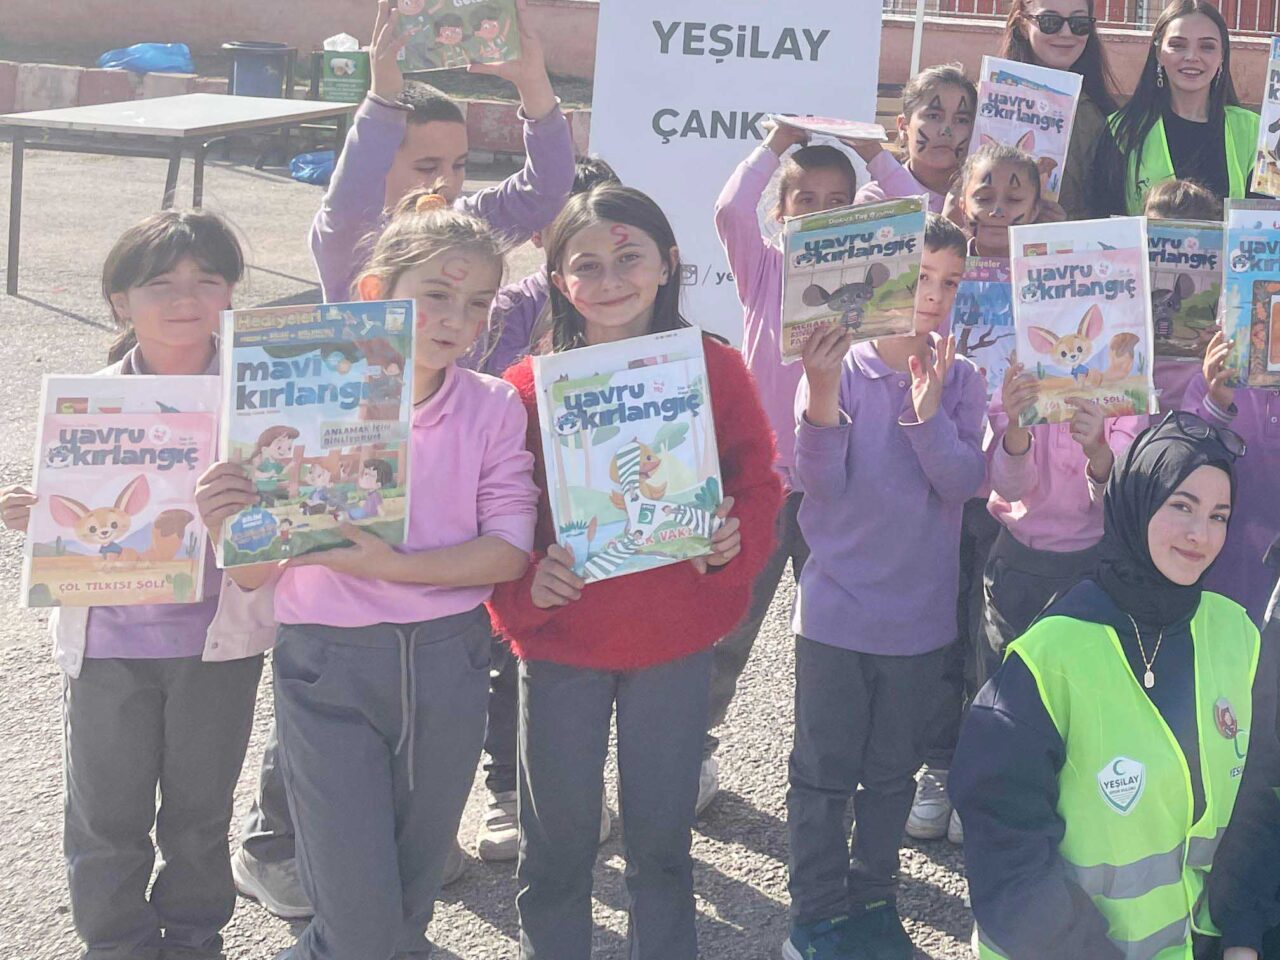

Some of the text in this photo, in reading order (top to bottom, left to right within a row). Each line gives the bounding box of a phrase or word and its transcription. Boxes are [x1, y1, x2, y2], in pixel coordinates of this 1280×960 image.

[988, 92, 1035, 111] yavru
[652, 108, 814, 145] ÇANK
[994, 107, 1064, 133] kırlangıç
[804, 231, 875, 253] yavru
[815, 237, 917, 265] kırlangıç
[1148, 237, 1183, 249] vru
[1149, 249, 1218, 271] rlangıç
[1027, 263, 1093, 283] yavru
[1040, 277, 1137, 300] kırlangıç
[236, 354, 322, 383] mavi
[563, 381, 645, 412] yavru
[580, 392, 700, 431] kırlangıç
[59, 426, 145, 449] yavru
[72, 444, 200, 471] kırlangıç
